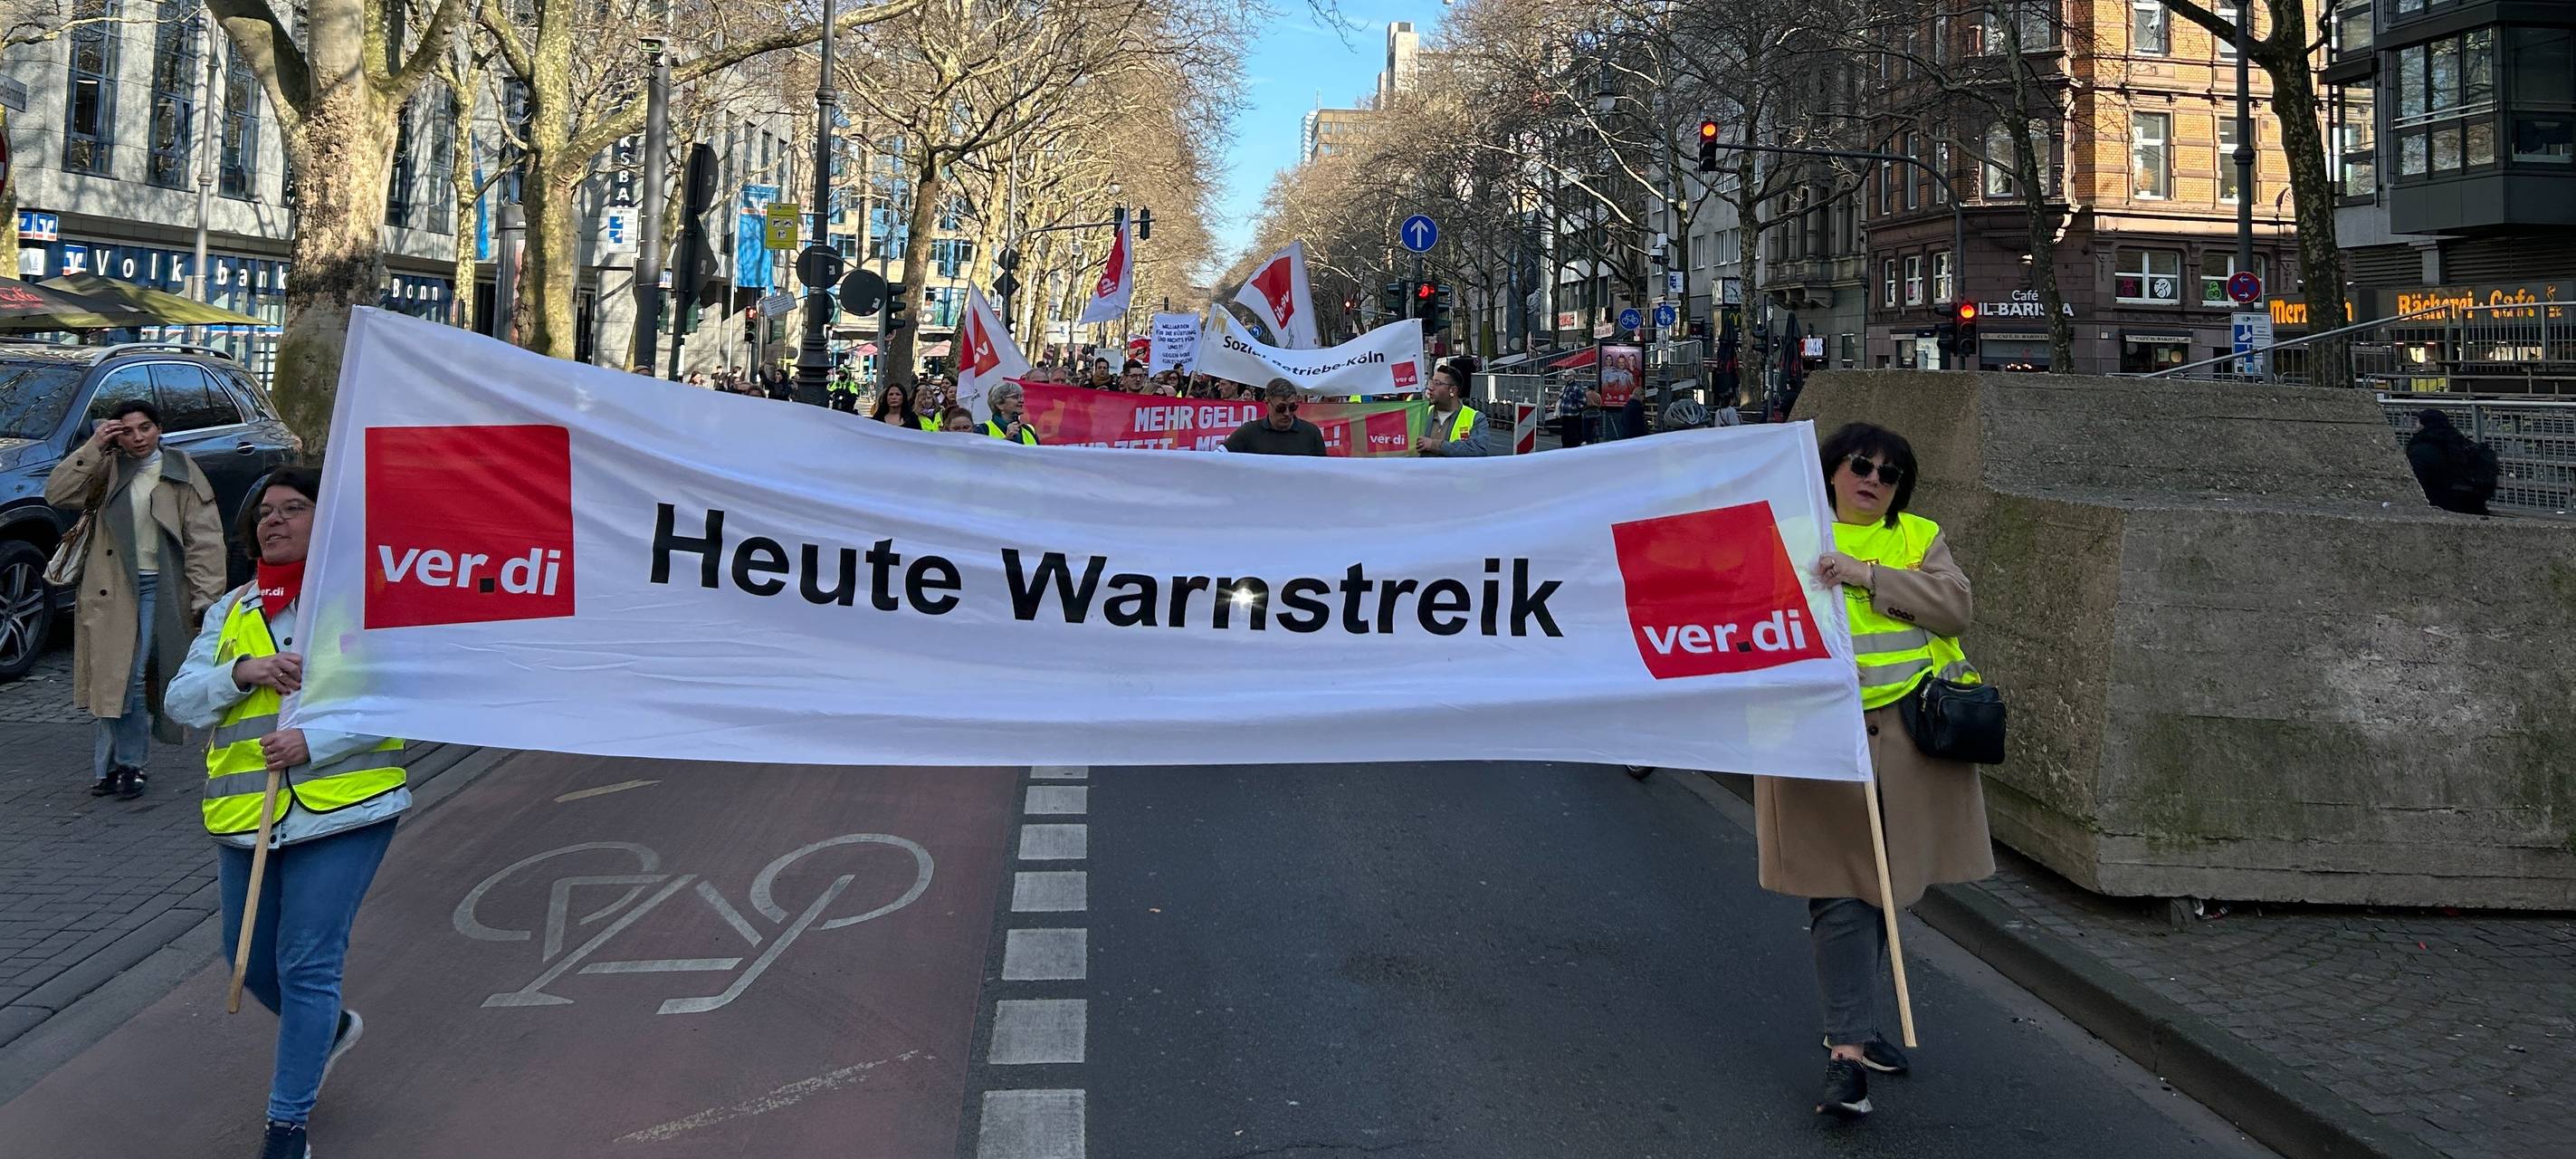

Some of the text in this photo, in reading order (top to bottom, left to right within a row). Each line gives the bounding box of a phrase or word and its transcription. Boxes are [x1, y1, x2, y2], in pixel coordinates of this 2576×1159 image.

[392, 278, 438, 301] Bonn
[2011, 290, 2038, 301] Café
[1979, 302, 1993, 315] IL
[2399, 290, 2474, 321] Bäckerei
[1134, 405, 1257, 433] MEHR GELD
[1369, 434, 1405, 445] ver.di
[378, 545, 561, 596] ver.di
[650, 502, 1564, 637] Heute Warnstreik
[258, 587, 284, 596] er.di
[1644, 608, 1807, 656] ver.di
